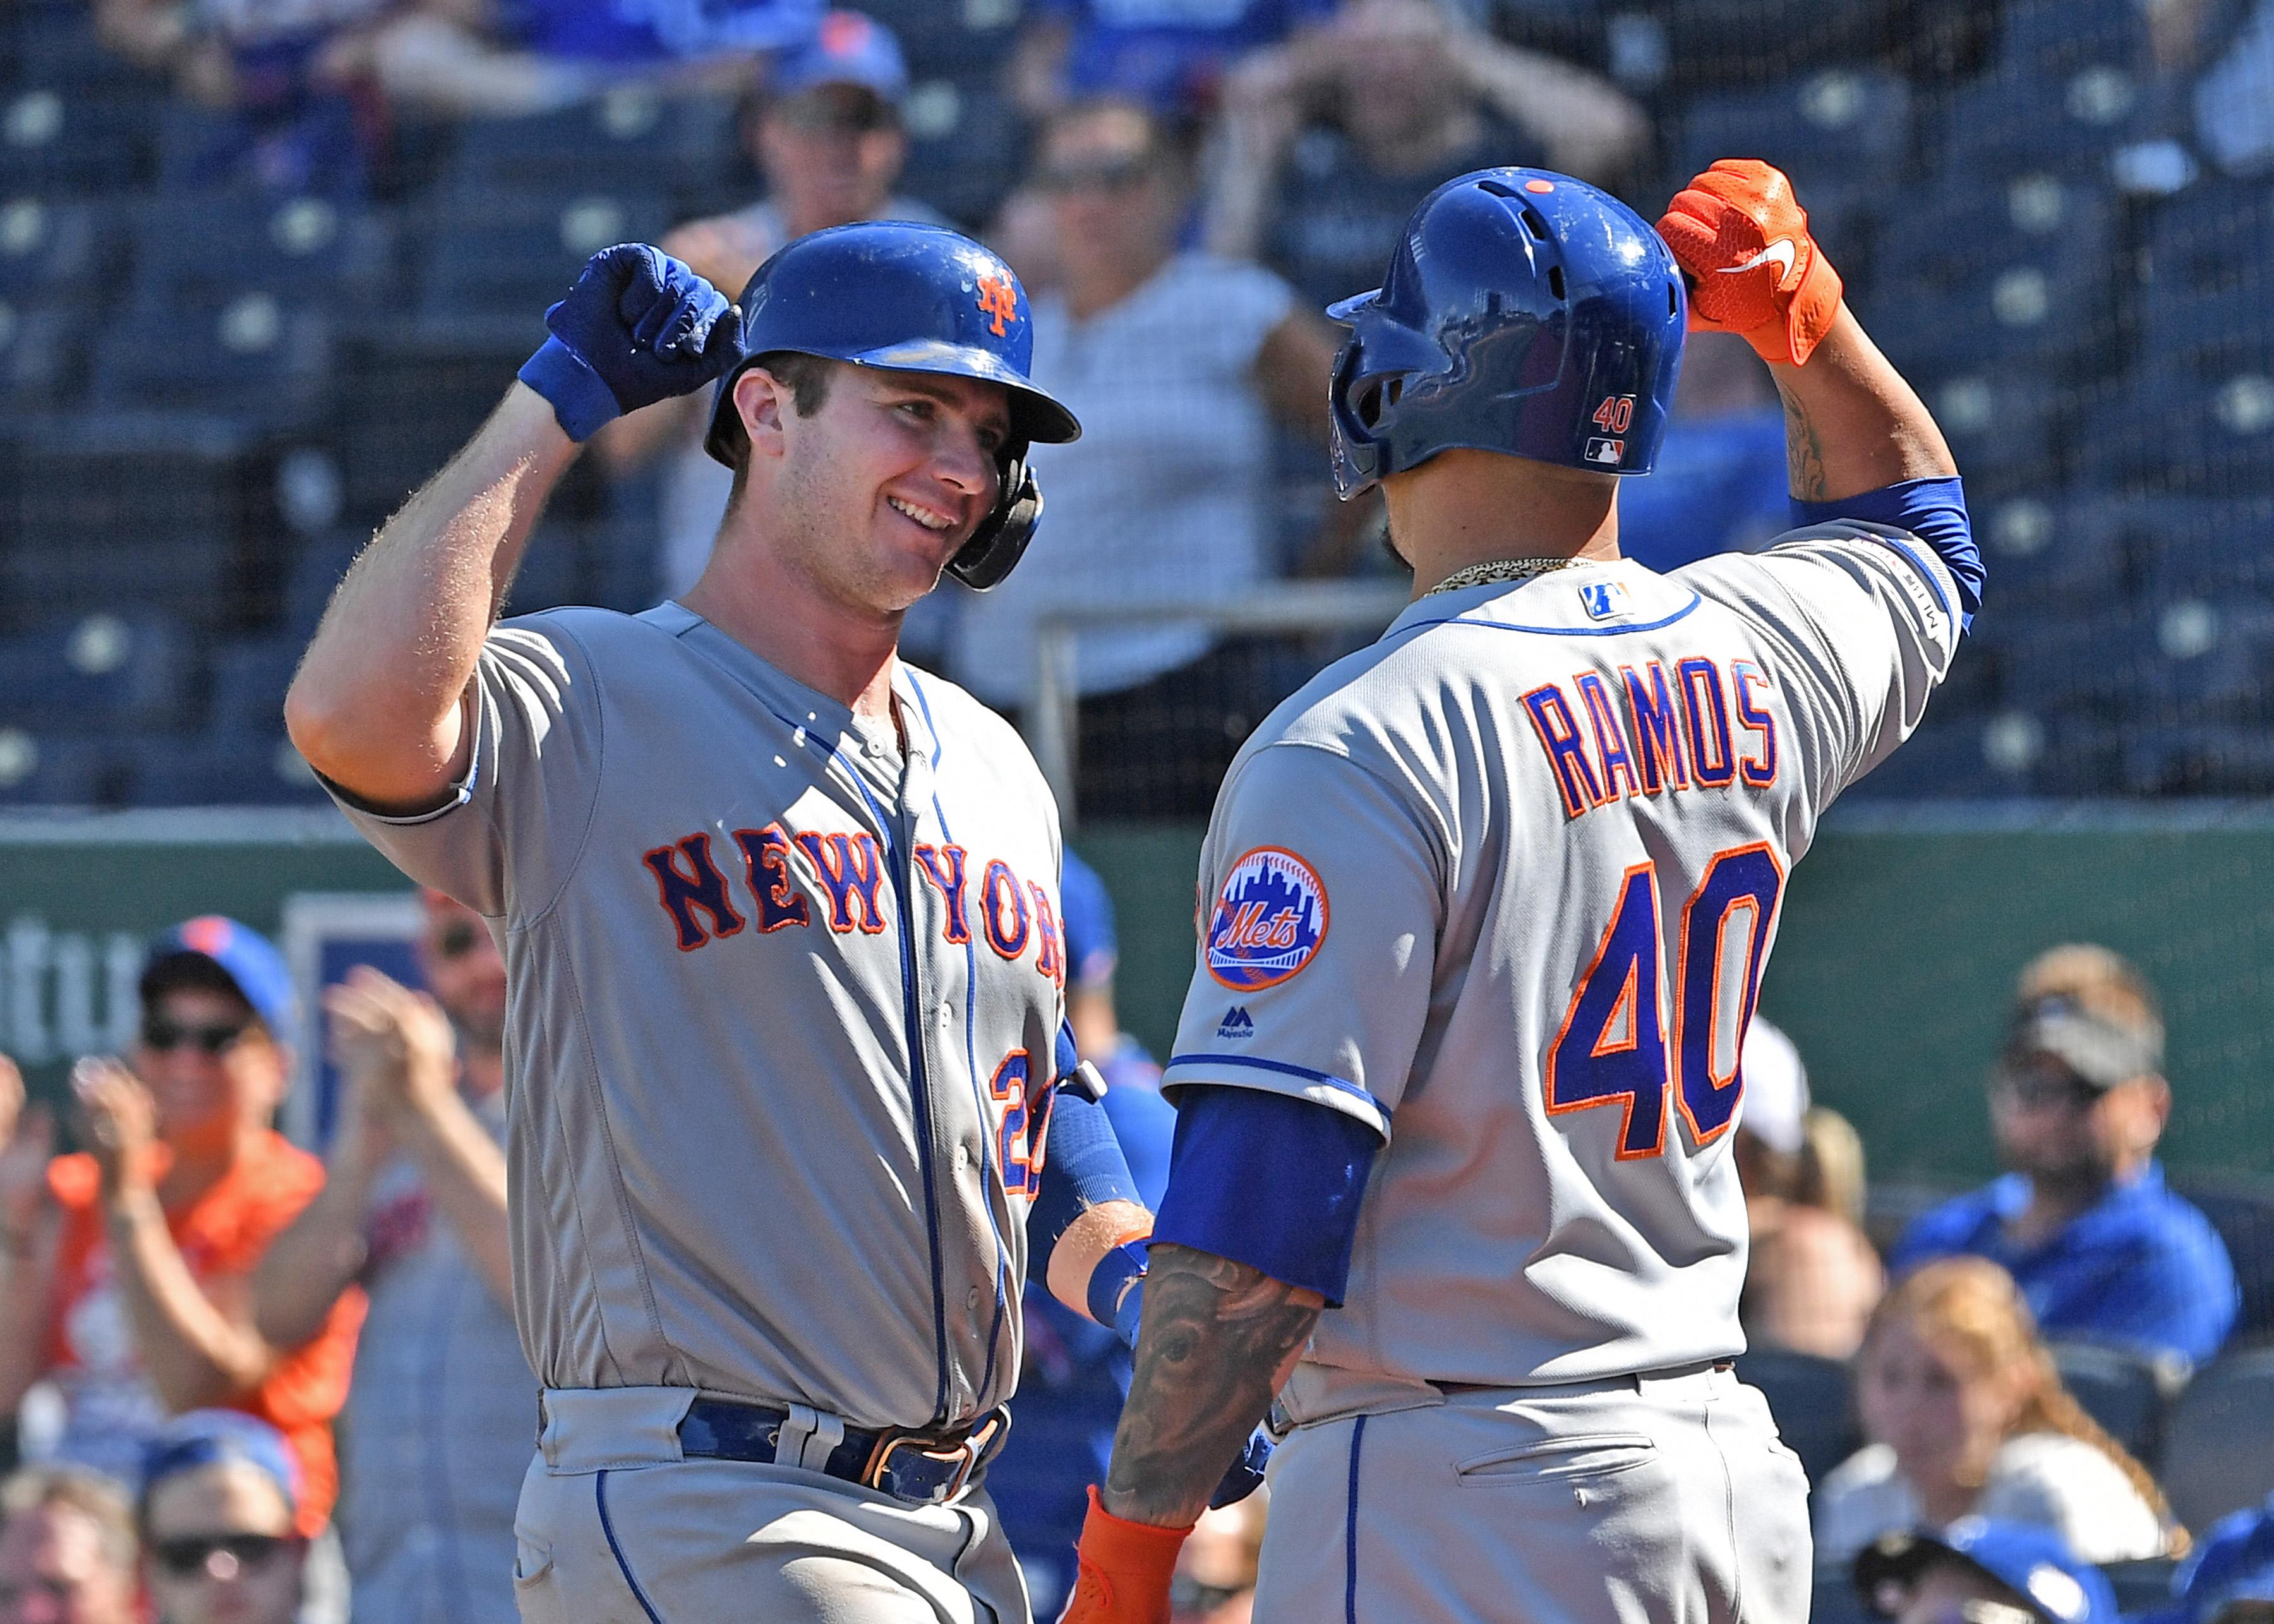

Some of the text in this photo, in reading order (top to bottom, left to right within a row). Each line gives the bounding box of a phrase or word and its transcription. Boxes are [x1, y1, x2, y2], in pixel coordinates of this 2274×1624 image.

[1592, 396, 1633, 433] 40
[1520, 655, 1779, 818] RAMOS
[642, 821, 1066, 989] NEW YOR
[1215, 901, 1303, 949] Mets
[1545, 840, 1785, 1161] 40
